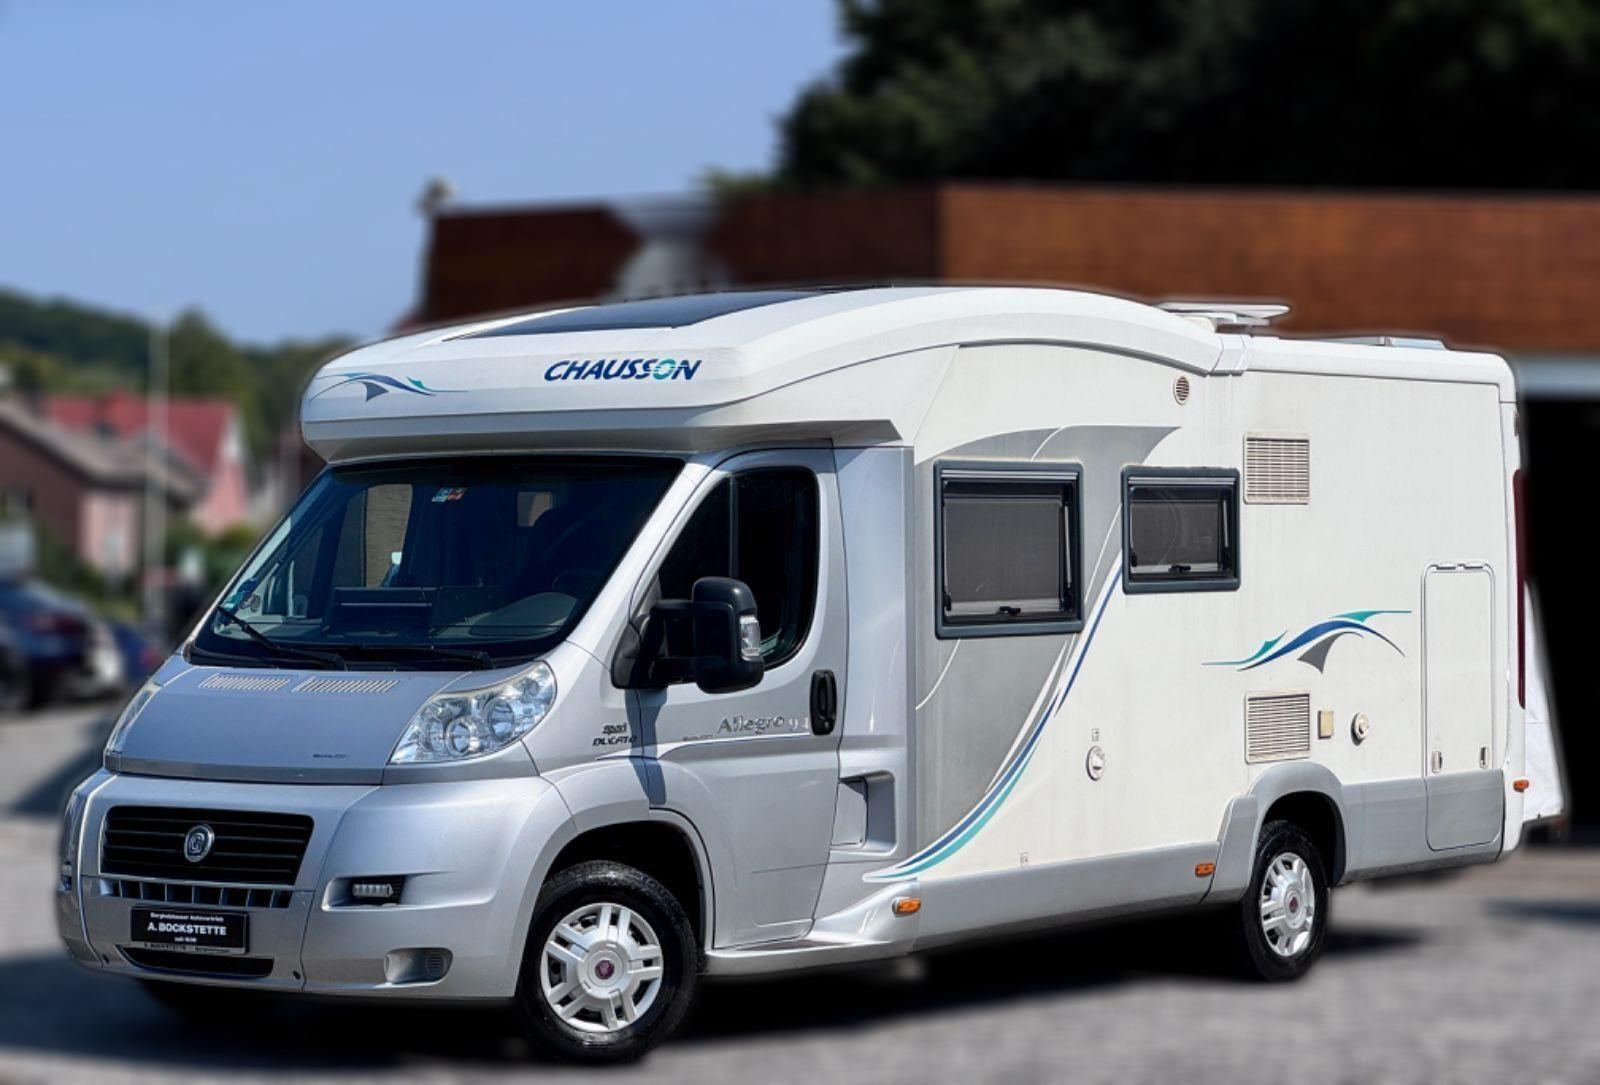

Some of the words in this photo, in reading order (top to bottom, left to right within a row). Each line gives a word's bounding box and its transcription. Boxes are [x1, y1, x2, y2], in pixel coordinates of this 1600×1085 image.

[544, 358, 702, 381] CHAUSSON
[717, 715, 785, 735] Allegro
[158, 922, 227, 936] BOCKSTETTE
